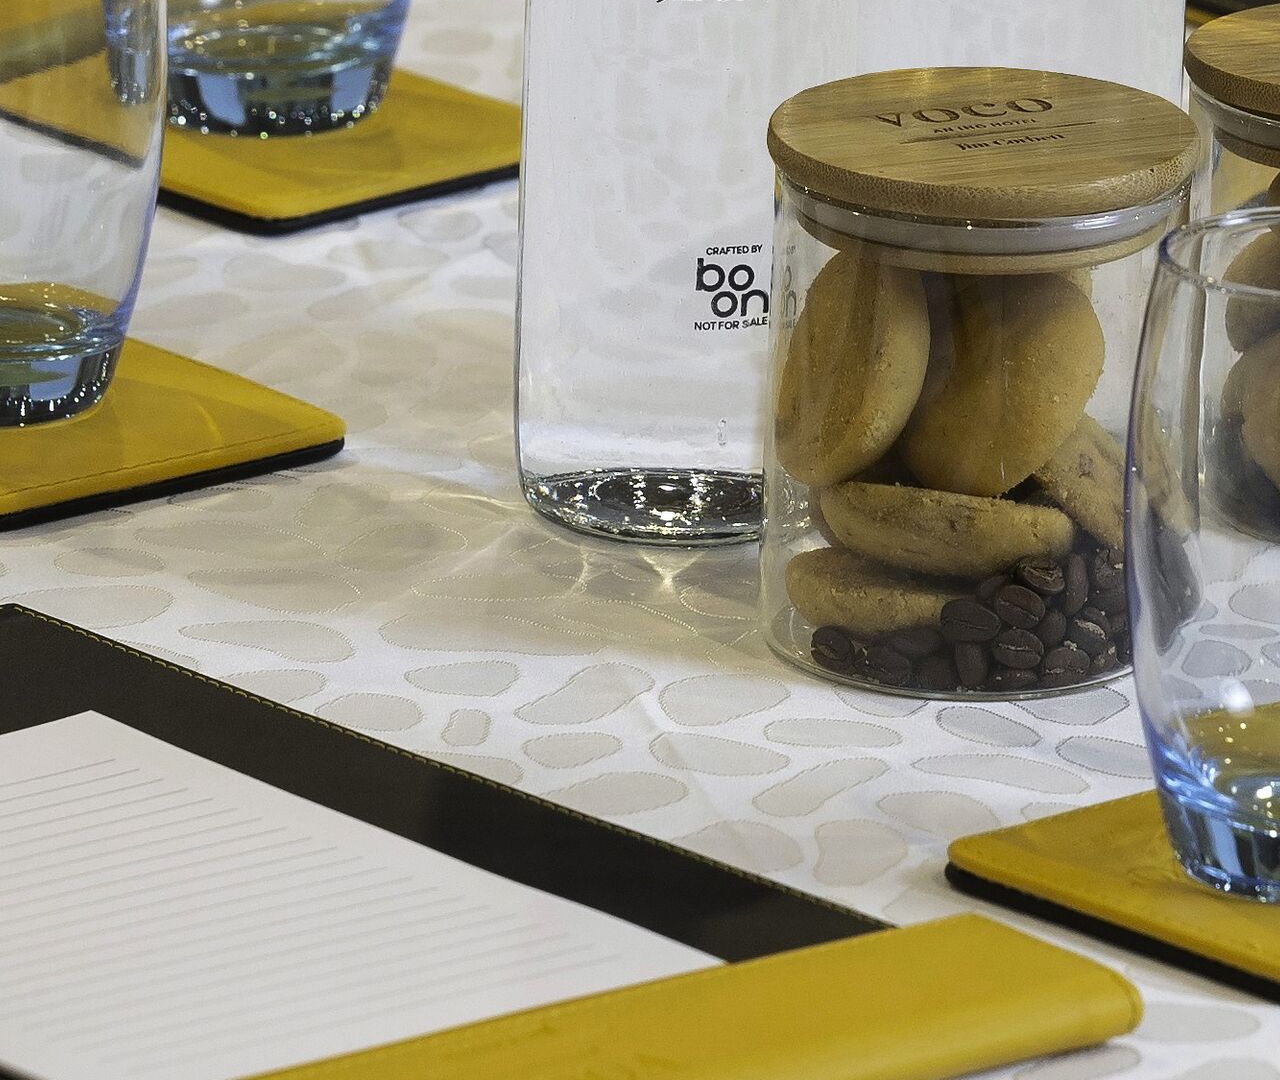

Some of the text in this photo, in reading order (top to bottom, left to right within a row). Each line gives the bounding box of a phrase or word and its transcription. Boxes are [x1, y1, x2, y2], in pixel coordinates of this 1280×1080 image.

[705, 244, 763, 256] CRAFTED BY
[694, 316, 769, 331] NOT FOR SALE
